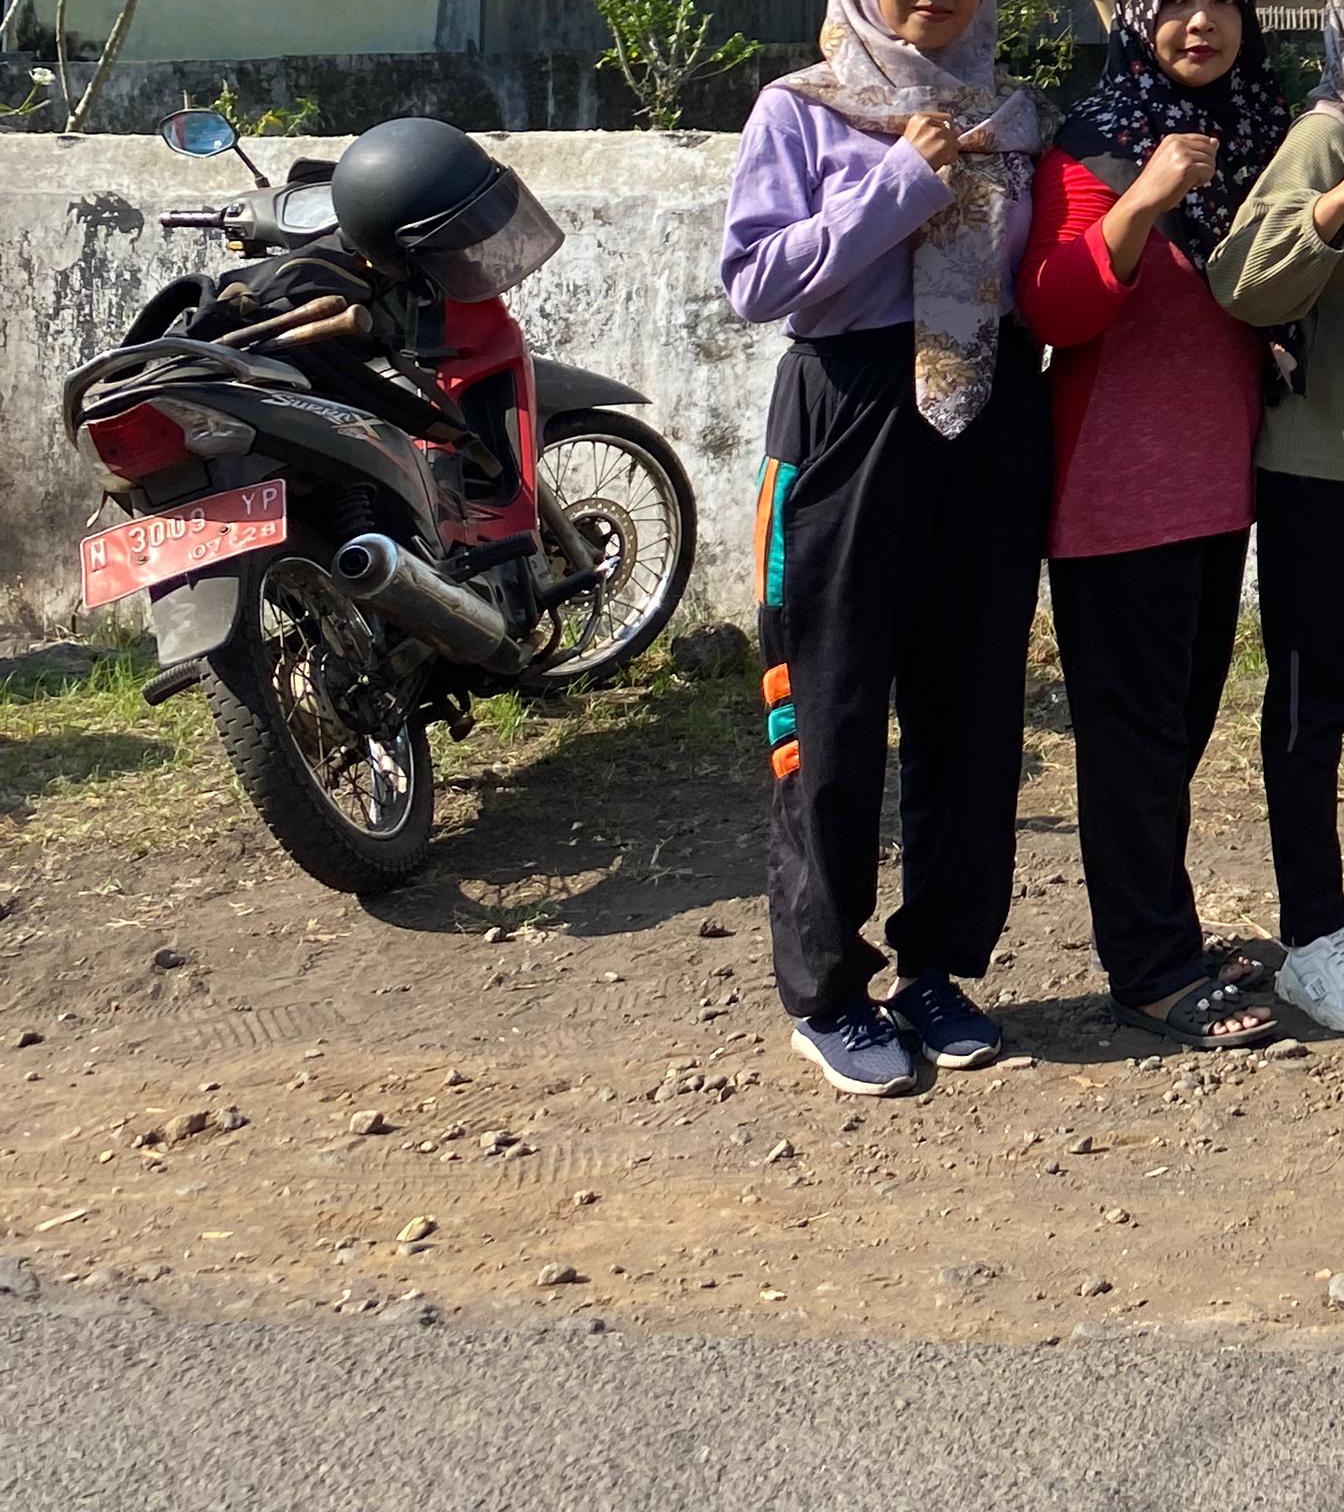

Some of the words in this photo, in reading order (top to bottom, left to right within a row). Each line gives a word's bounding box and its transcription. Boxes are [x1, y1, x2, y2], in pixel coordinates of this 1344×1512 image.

[90, 538, 107, 568] N
[129, 508, 207, 553] 3009
[242, 487, 278, 516] YP
